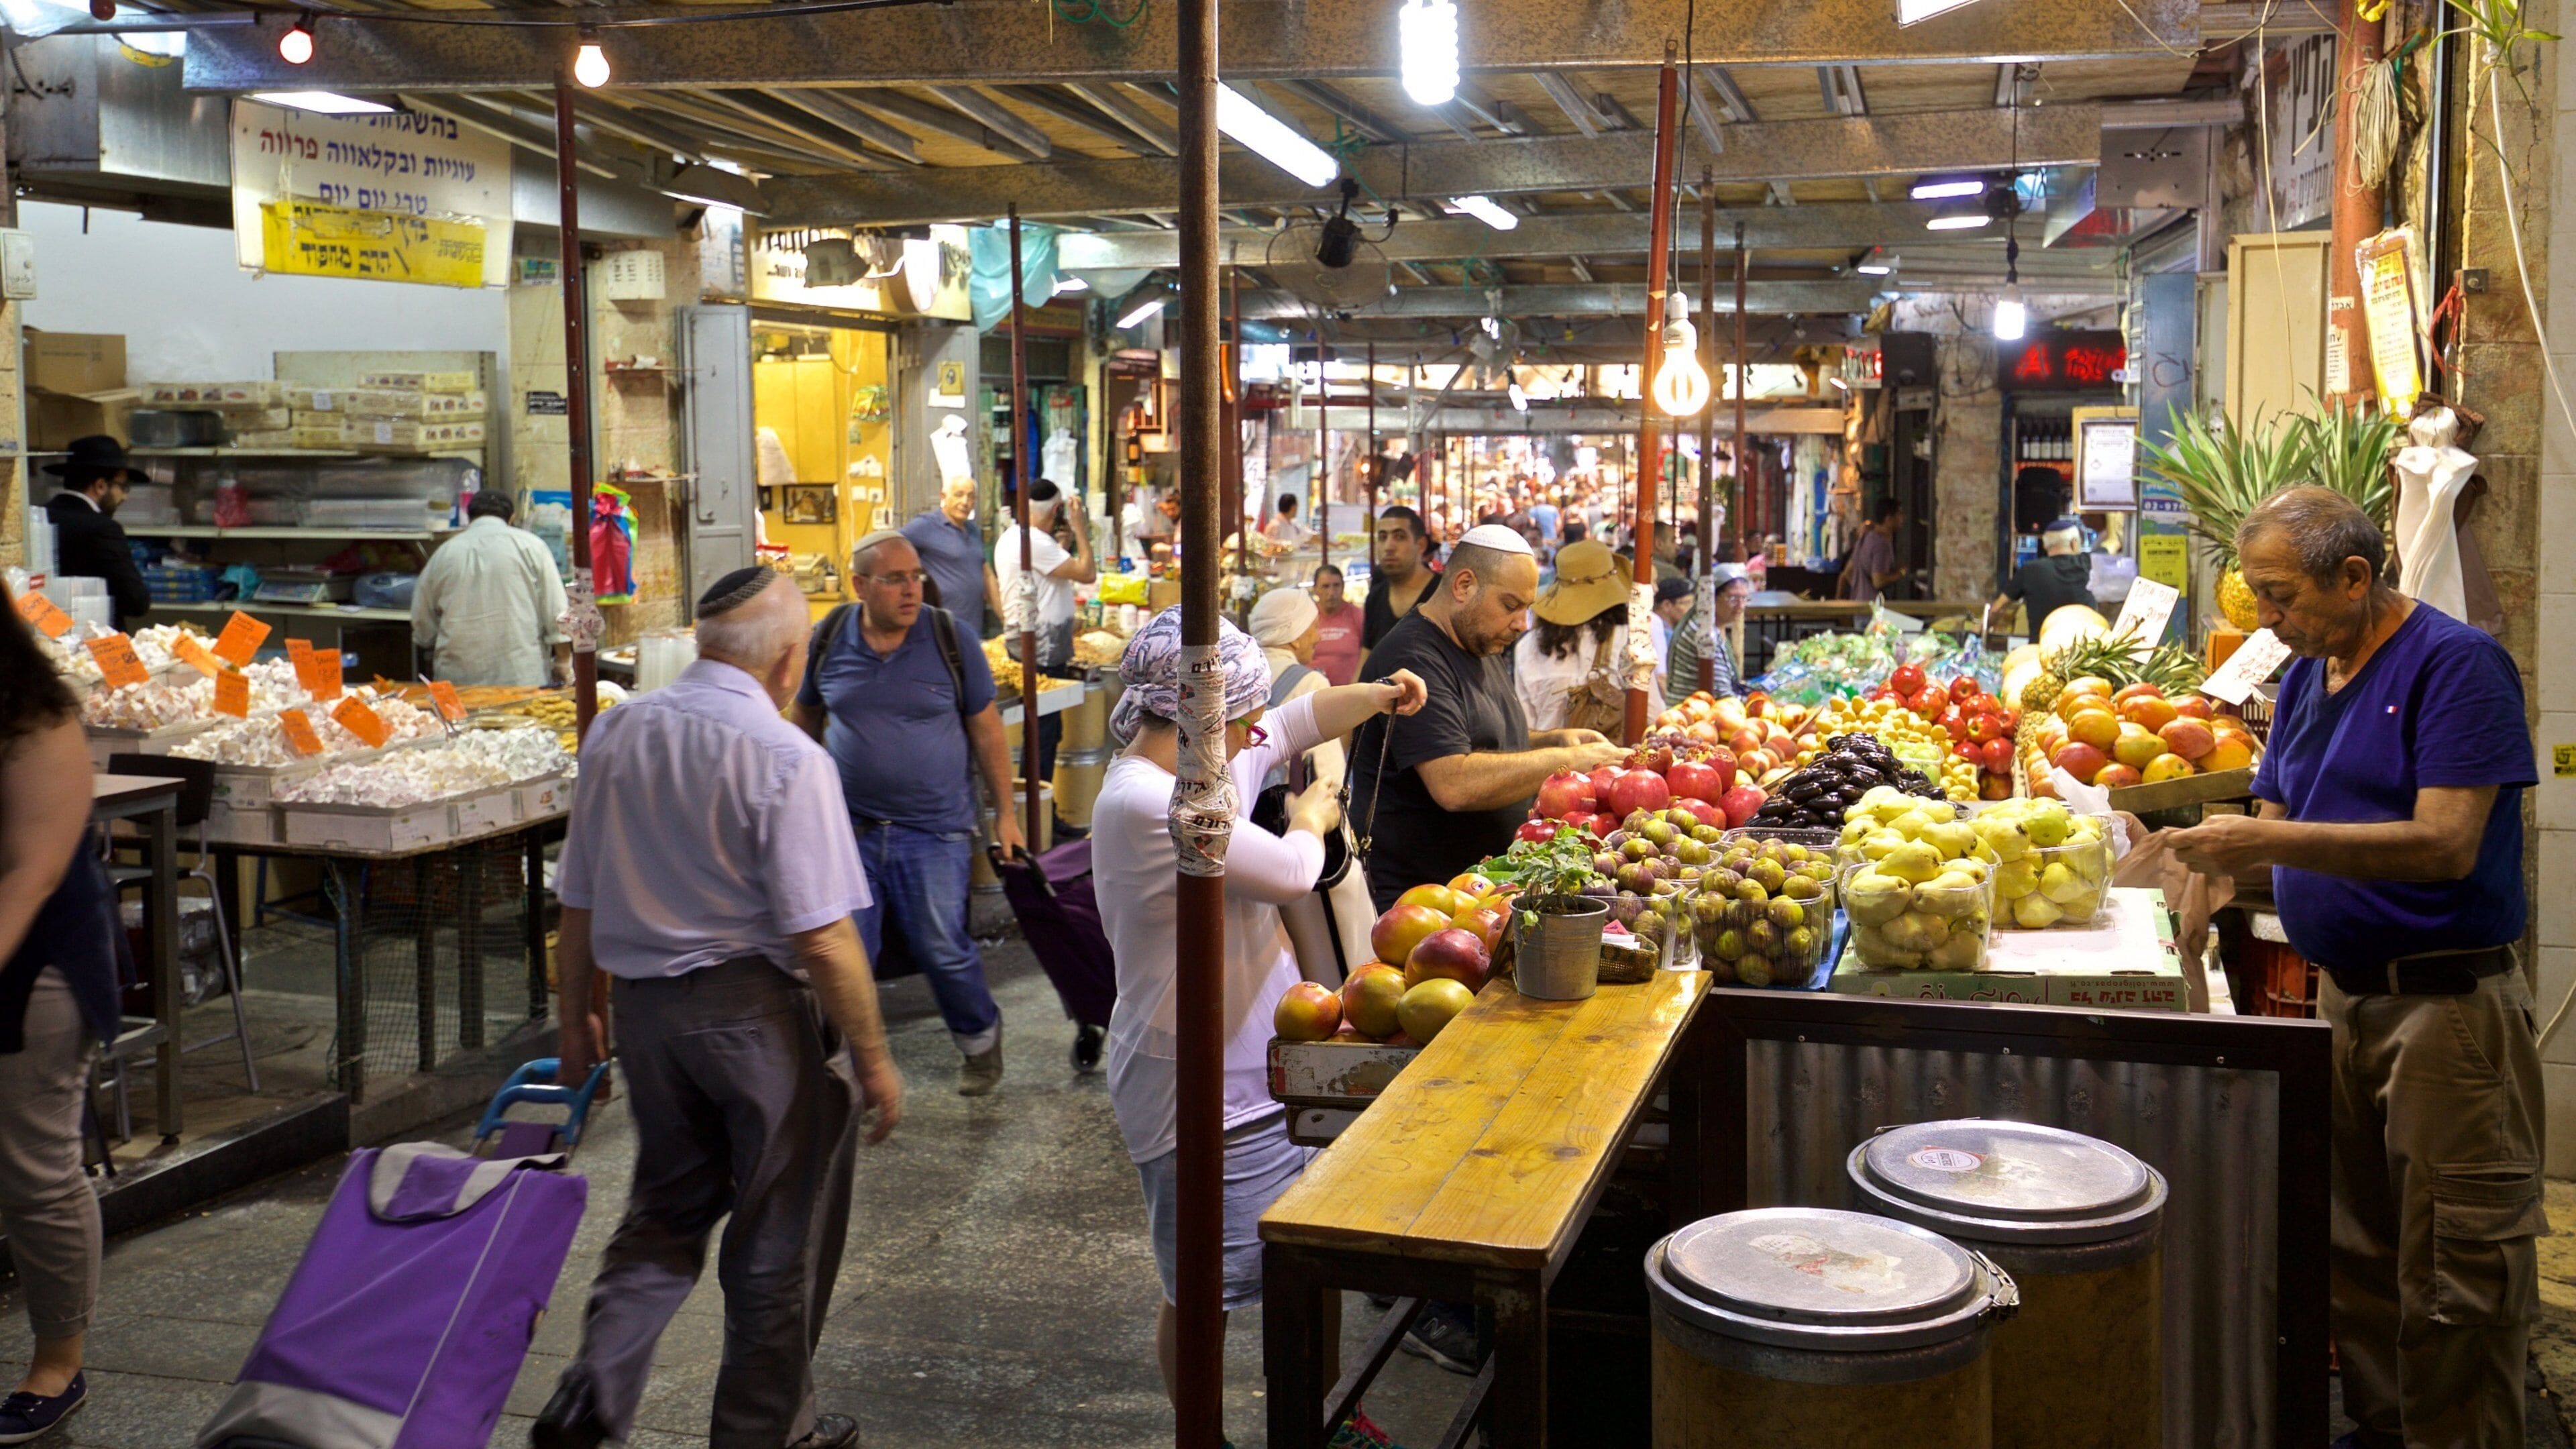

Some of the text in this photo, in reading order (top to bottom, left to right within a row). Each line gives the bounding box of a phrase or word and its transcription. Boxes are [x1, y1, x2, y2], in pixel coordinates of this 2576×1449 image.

[260, 128, 319, 160] פרווה
[423, 157, 475, 183] עוגיות
[319, 181, 350, 205] יום
[357, 188, 387, 209] יום
[394, 192, 427, 215] טרי
[2143, 989, 2176, 1003] זהב
